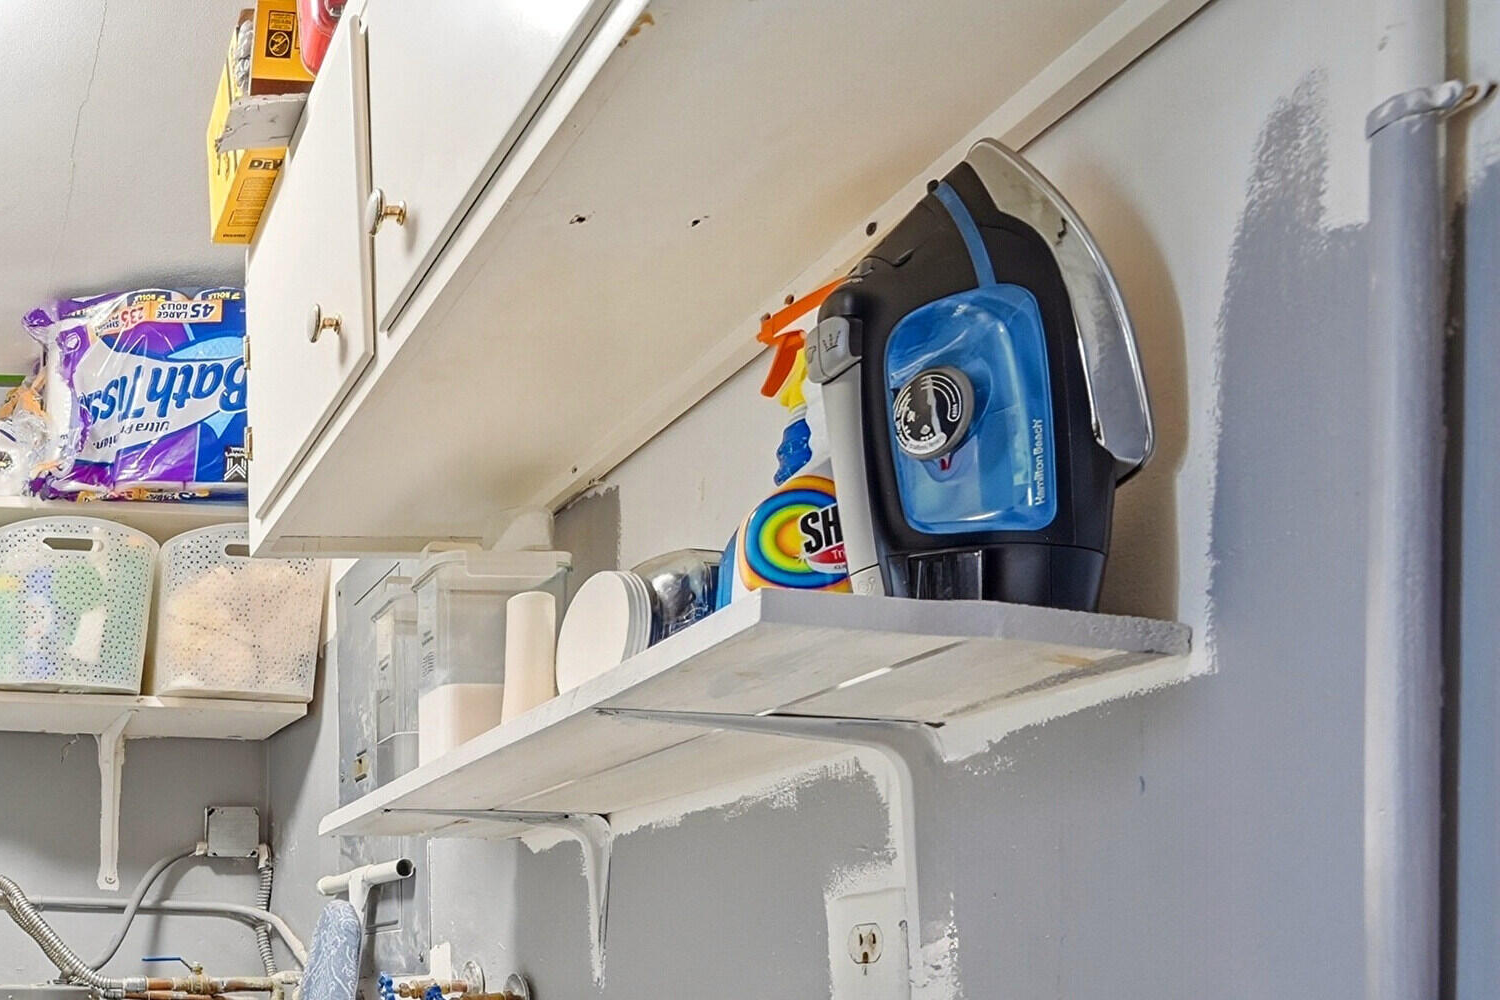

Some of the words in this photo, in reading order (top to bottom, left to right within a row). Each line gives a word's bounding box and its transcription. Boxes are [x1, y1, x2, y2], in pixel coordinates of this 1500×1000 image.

[156, 310, 188, 319] LARGE
[189, 303, 215, 319] 45
[146, 357, 247, 418] Bath
